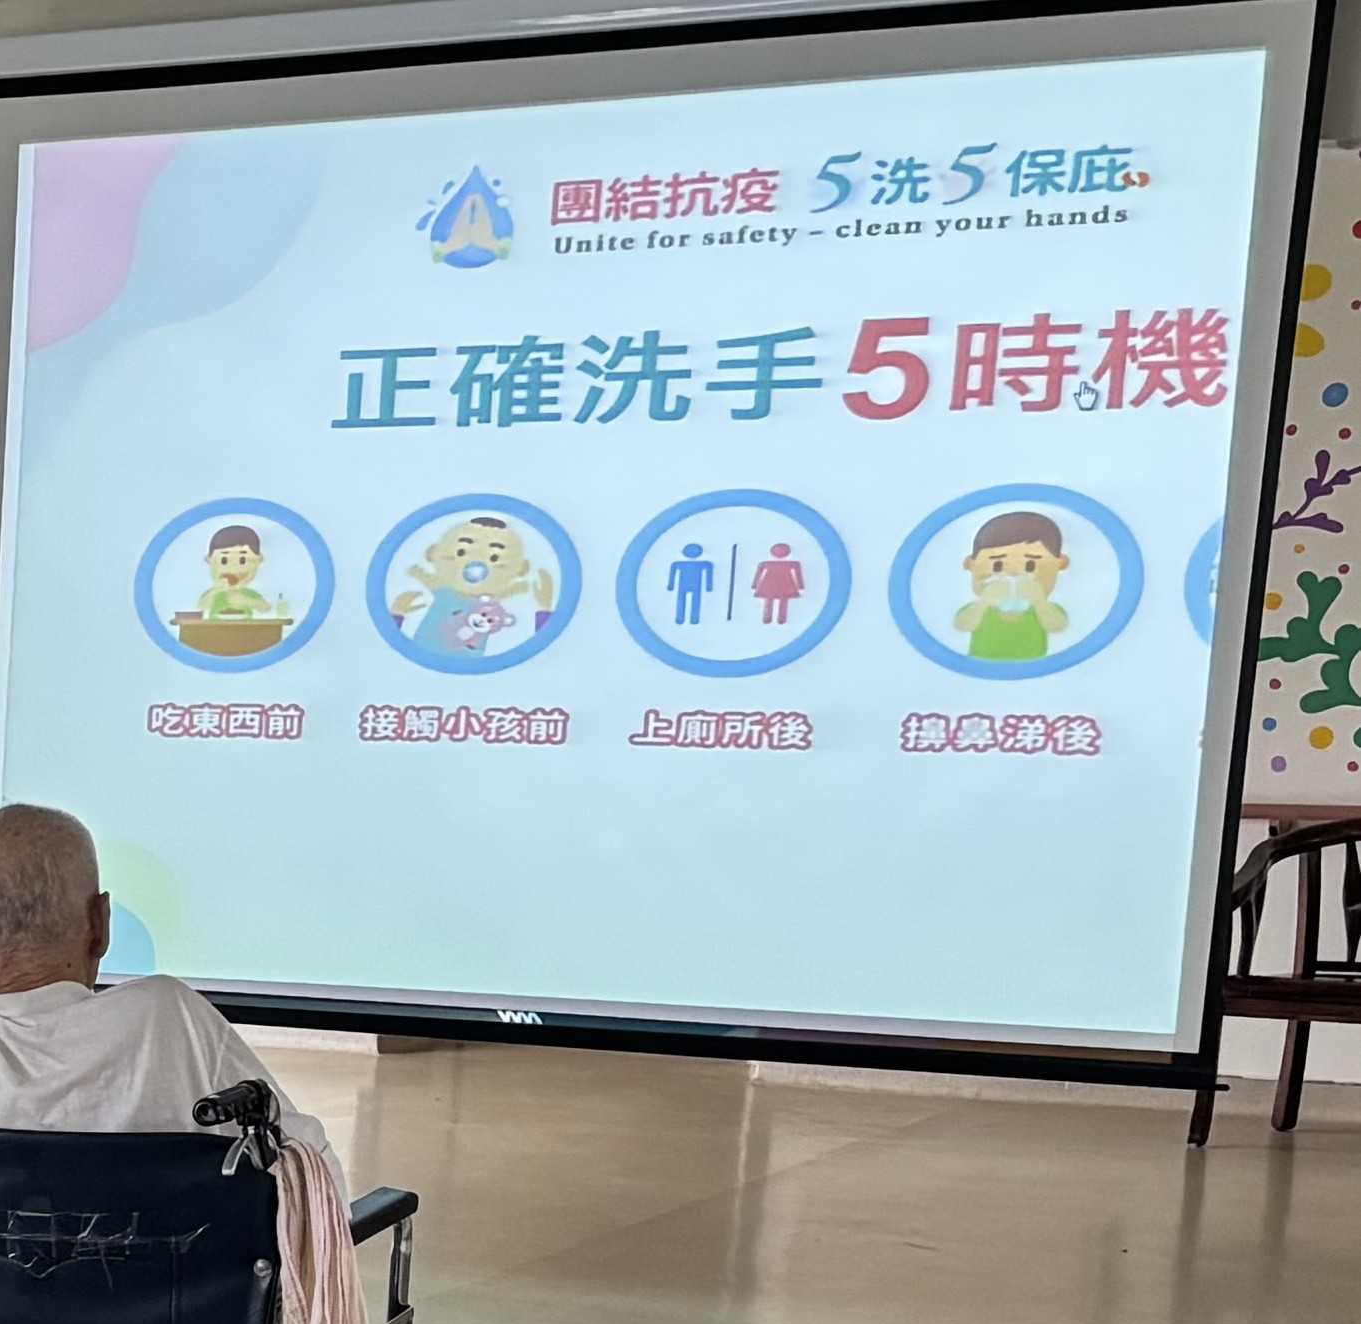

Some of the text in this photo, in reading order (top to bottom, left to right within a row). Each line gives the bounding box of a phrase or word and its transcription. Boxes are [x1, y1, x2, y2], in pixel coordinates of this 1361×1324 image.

[551, 167, 780, 226] 團結抗疫
[554, 234, 636, 255] Unite
[646, 230, 691, 249] for
[702, 225, 797, 247] safety
[835, 219, 922, 239] clean
[935, 214, 1012, 238] your
[1025, 204, 1128, 228] hands
[148, 703, 305, 740] 吃東西前
[359, 704, 569, 745] 接觸小孩前
[629, 709, 813, 751] 上廁所後
